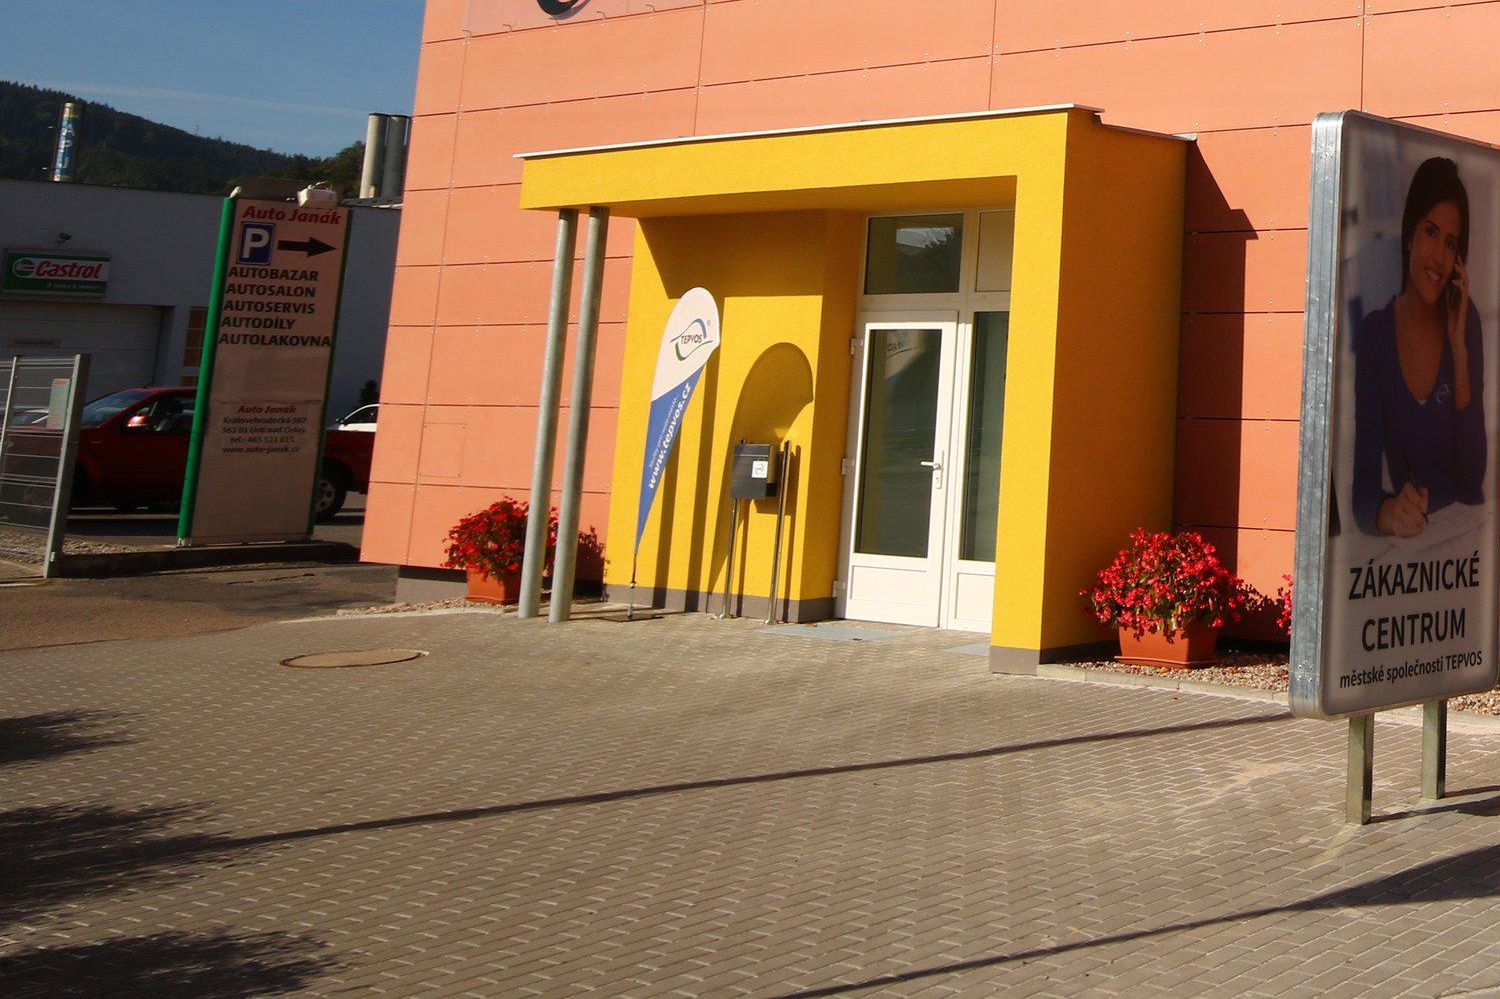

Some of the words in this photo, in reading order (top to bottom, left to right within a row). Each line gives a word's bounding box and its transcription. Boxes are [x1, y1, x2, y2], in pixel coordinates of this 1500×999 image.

[242, 205, 286, 221] Auto
[288, 208, 342, 225] Janák
[242, 227, 270, 259] P
[36, 260, 103, 279] Castrol
[228, 266, 319, 281] AUTOBAZAR
[225, 283, 316, 298] AUTOSALON
[223, 300, 316, 314] AUTOSERVIS
[220, 315, 295, 330] AUTODÍLY
[219, 333, 332, 347] AUTOLAKOVNA
[681, 334, 703, 345] TEPVOS
[237, 405, 263, 414] Auto
[264, 405, 297, 414] Janák
[648, 382, 692, 489] www.tepvos.cz
[1348, 550, 1480, 600] ZÁKAZNICKÉ
[1361, 608, 1466, 652] CENTRUM
[1340, 665, 1385, 688] městské
[1386, 656, 1444, 684] společnosti
[1445, 650, 1483, 669] TEPVOS
